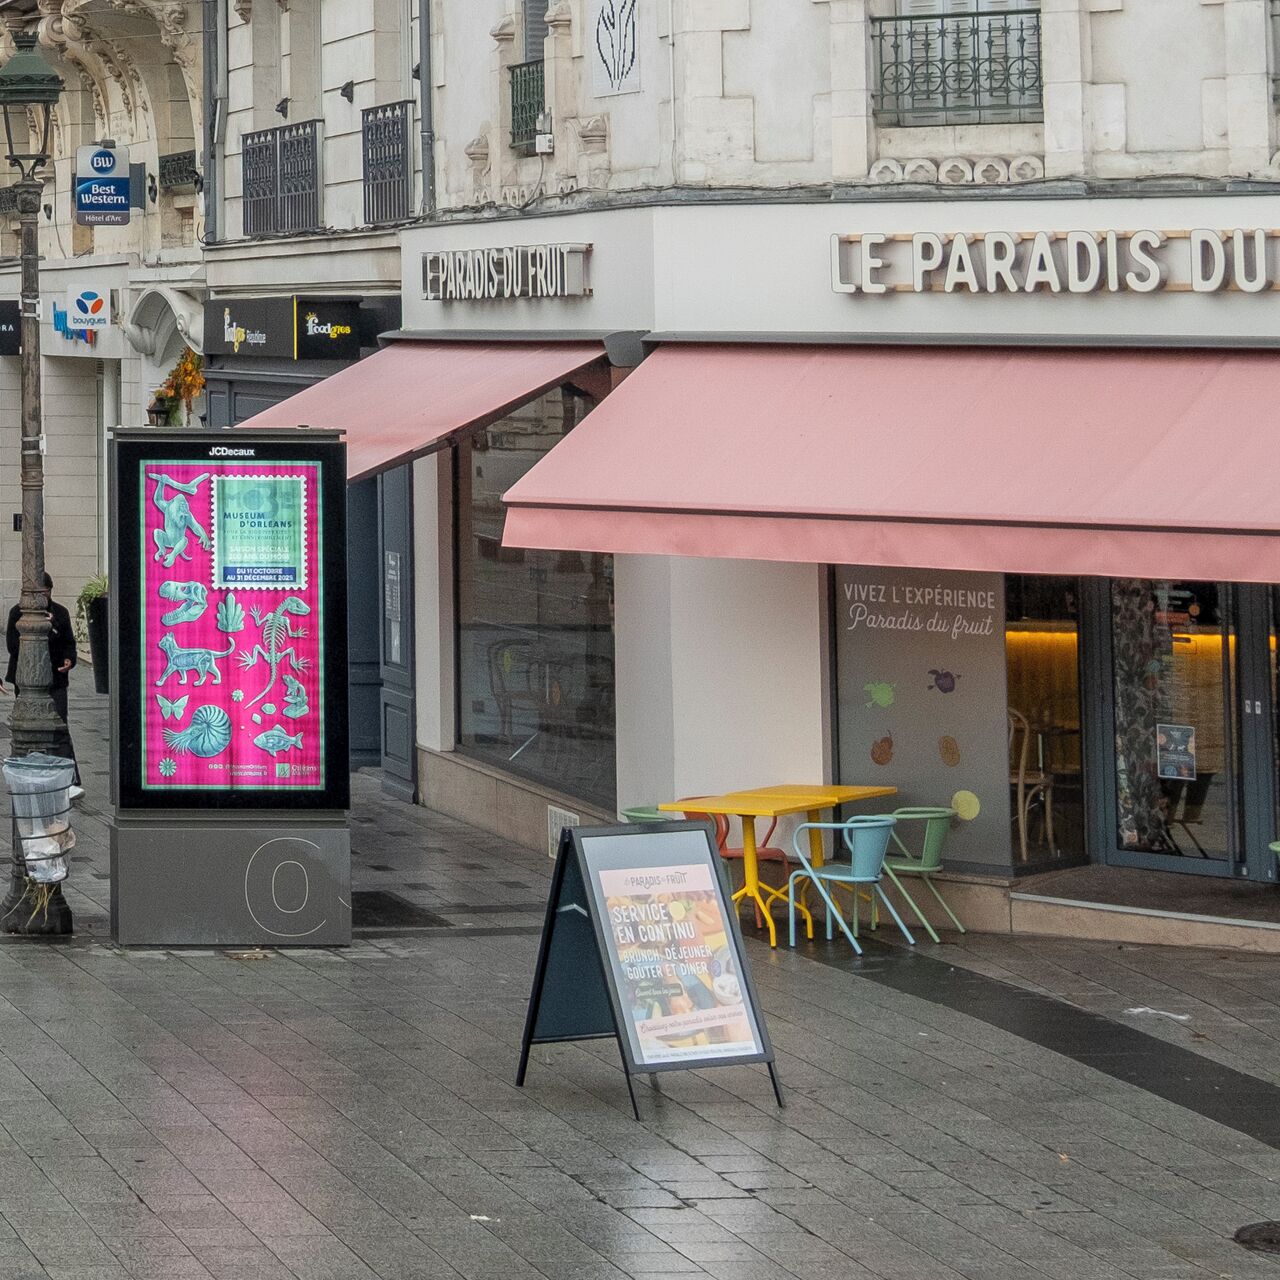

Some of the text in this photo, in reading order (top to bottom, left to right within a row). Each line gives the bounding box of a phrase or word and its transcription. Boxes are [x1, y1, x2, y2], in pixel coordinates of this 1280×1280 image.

[93, 157, 115, 167] BW
[91, 184, 115, 194] Best
[81, 194, 127, 204] Western
[85, 214, 122, 222] Hôtel d'Arc
[830, 228, 1268, 294] LE PARADIS DU
[421, 245, 570, 300] LE PARADIS DU FRUIT
[73, 316, 106, 326] bouygues
[209, 447, 255, 456] JCDecaux
[844, 583, 995, 609] VIVEZ L'EXPÉRIENCE
[848, 603, 994, 640] Paradis du fruit
[630, 872, 688, 889] PARADIS FRUIT
[613, 903, 668, 923] SERVICE
[618, 922, 695, 944] EN CONTINU
[665, 944, 713, 960] DÉJEUNER
[666, 964, 677, 976] ET
